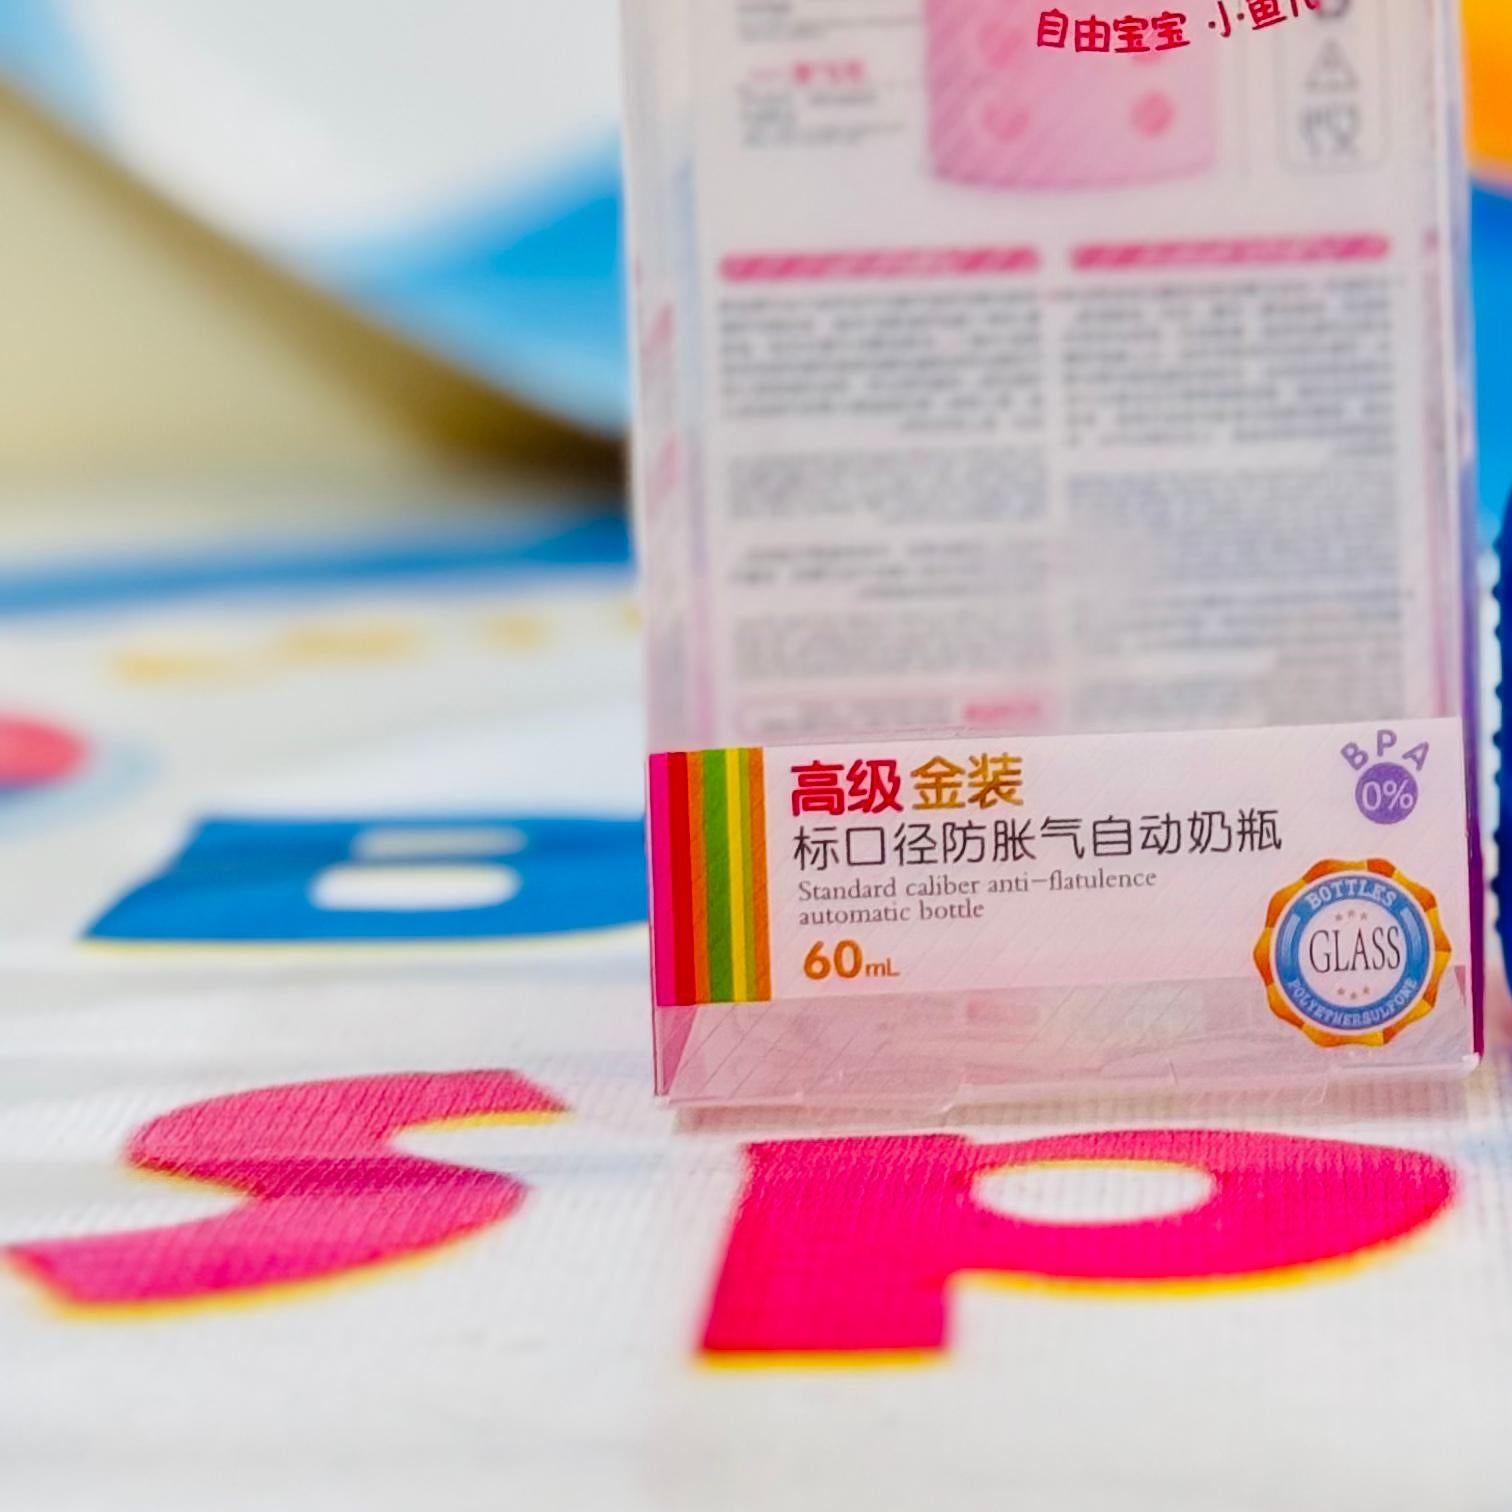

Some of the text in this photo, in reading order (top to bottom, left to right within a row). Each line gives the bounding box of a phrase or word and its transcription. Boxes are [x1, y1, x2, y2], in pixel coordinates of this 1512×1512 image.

[1037, 8, 1190, 53] 自由宝宝
[1340, 729, 1429, 771] BPA
[791, 752, 1024, 816] 高级 金装
[1362, 779, 1413, 810] 0%
[793, 808, 1283, 871] 标口径防胀气自动奶瓶
[799, 876, 897, 901] Standard
[905, 874, 981, 898] caliber
[1304, 878, 1398, 910] BOTTLES
[799, 899, 985, 925] automatic bottle
[1309, 926, 1401, 973] GLASS
[1287, 977, 1418, 1026] POLYETHERSULFONE
